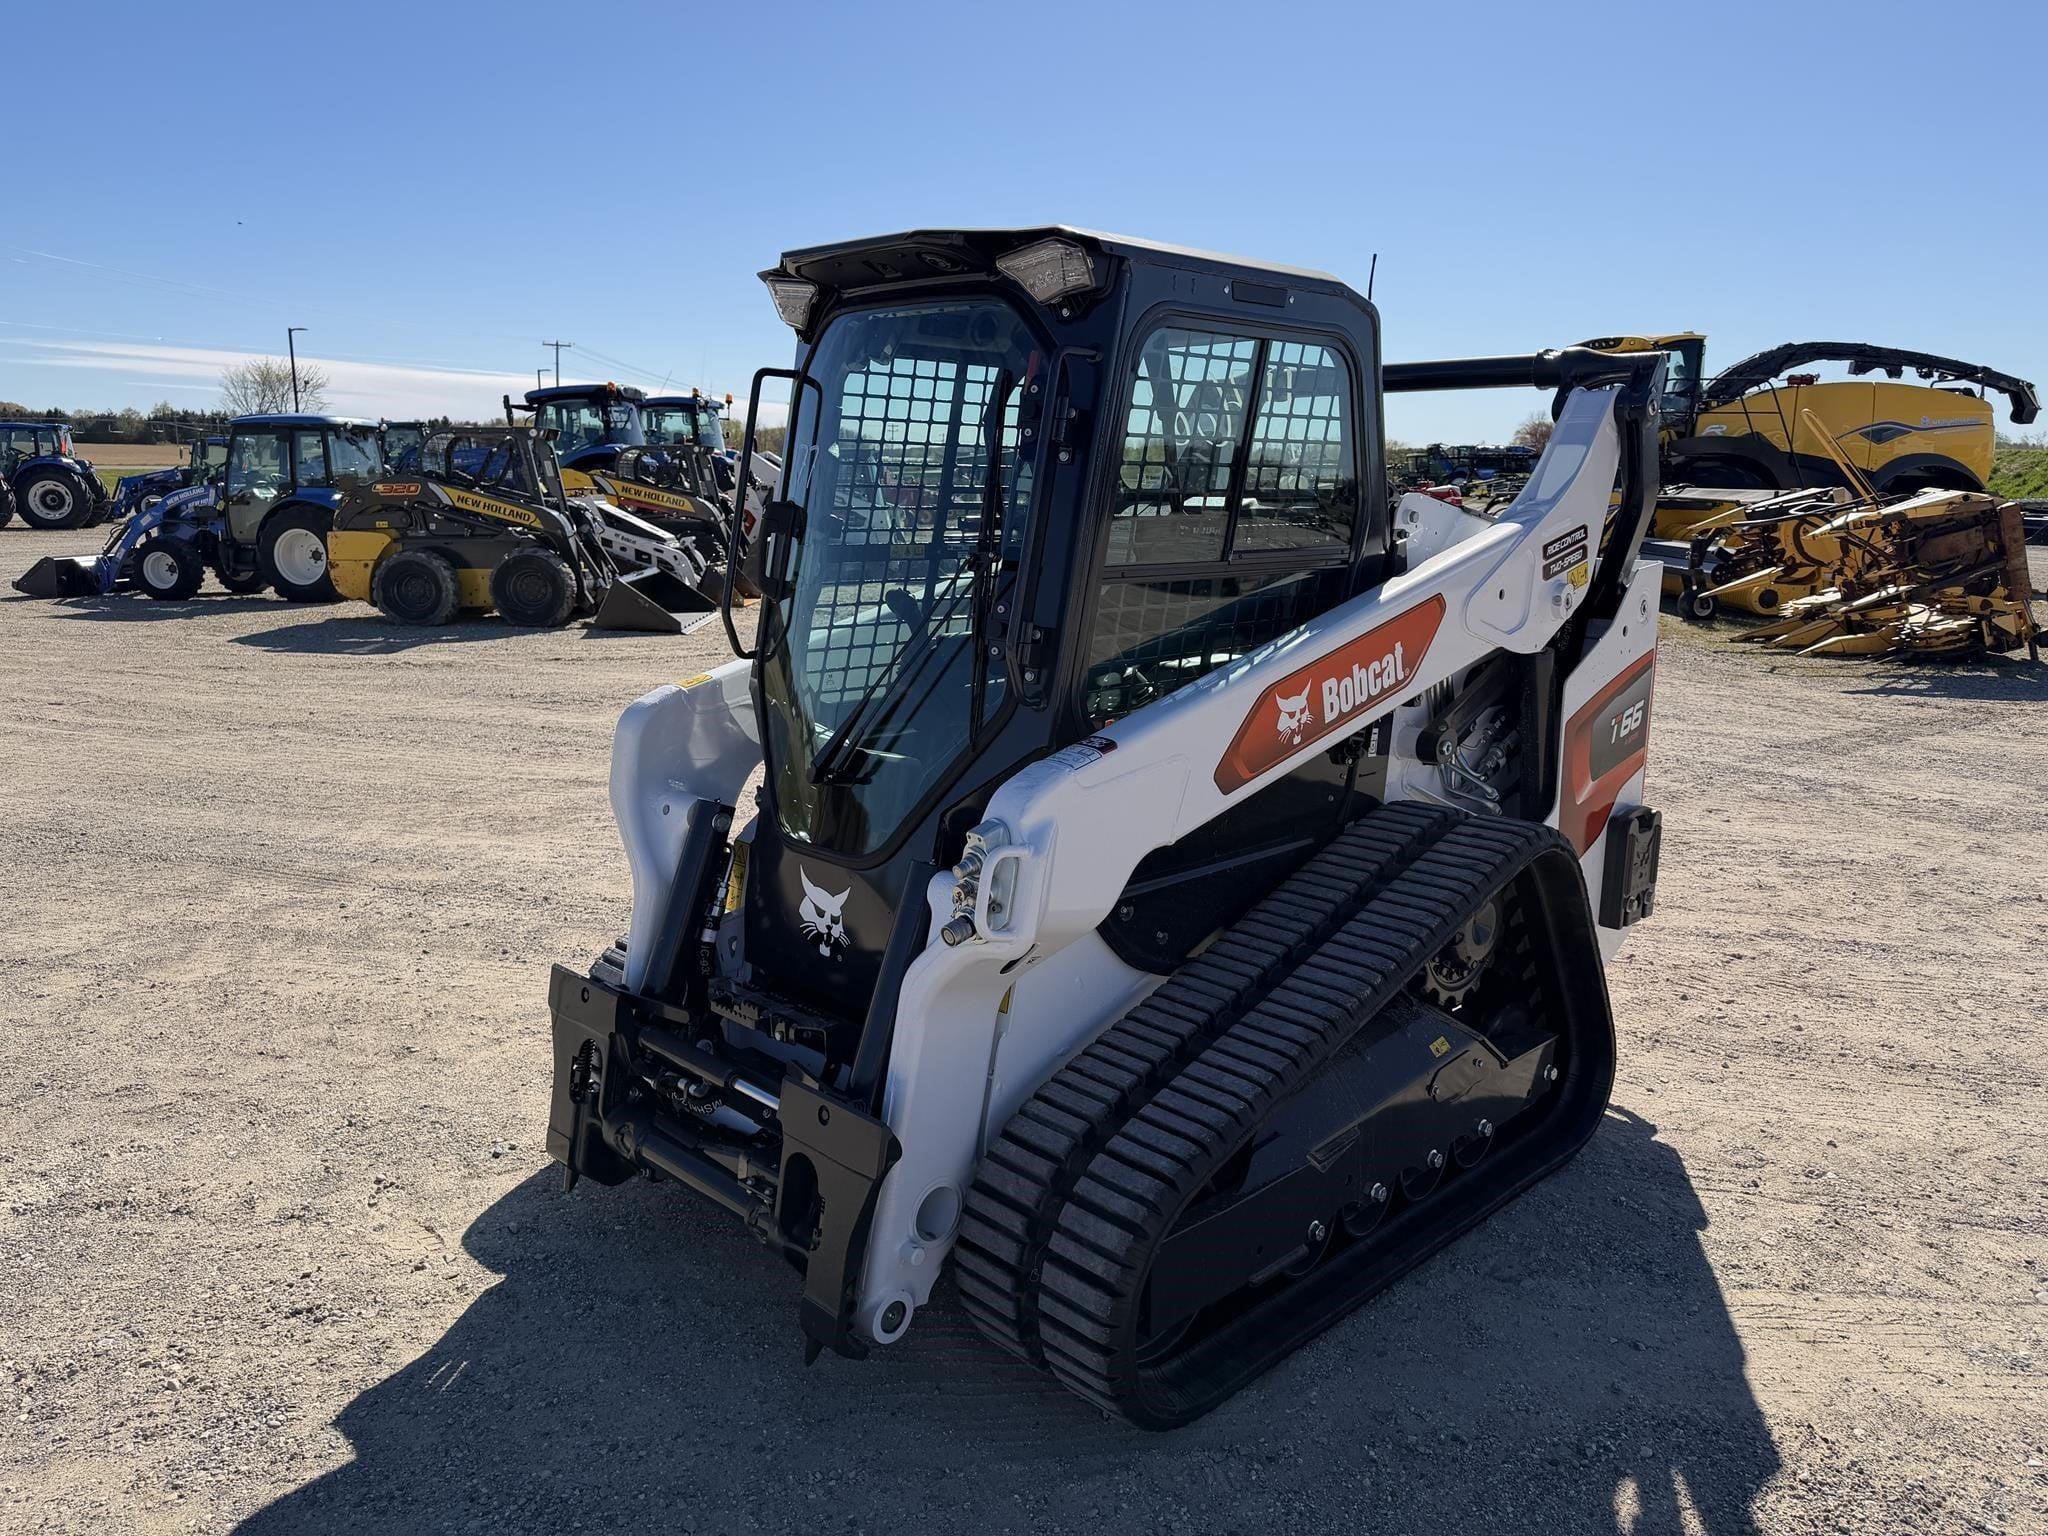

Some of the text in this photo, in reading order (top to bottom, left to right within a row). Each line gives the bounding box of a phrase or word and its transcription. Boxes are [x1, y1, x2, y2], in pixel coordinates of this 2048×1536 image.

[372, 483, 421, 495] L320
[621, 485, 685, 508] NEW HOLLAND
[457, 494, 531, 522] NEW HOLLAND
[1547, 528, 1586, 557] RIDE CONTROL
[1550, 549, 1584, 575] TWO-SPEED
[1321, 640, 1405, 724] Bobcat
[1611, 699, 1645, 745] T66
